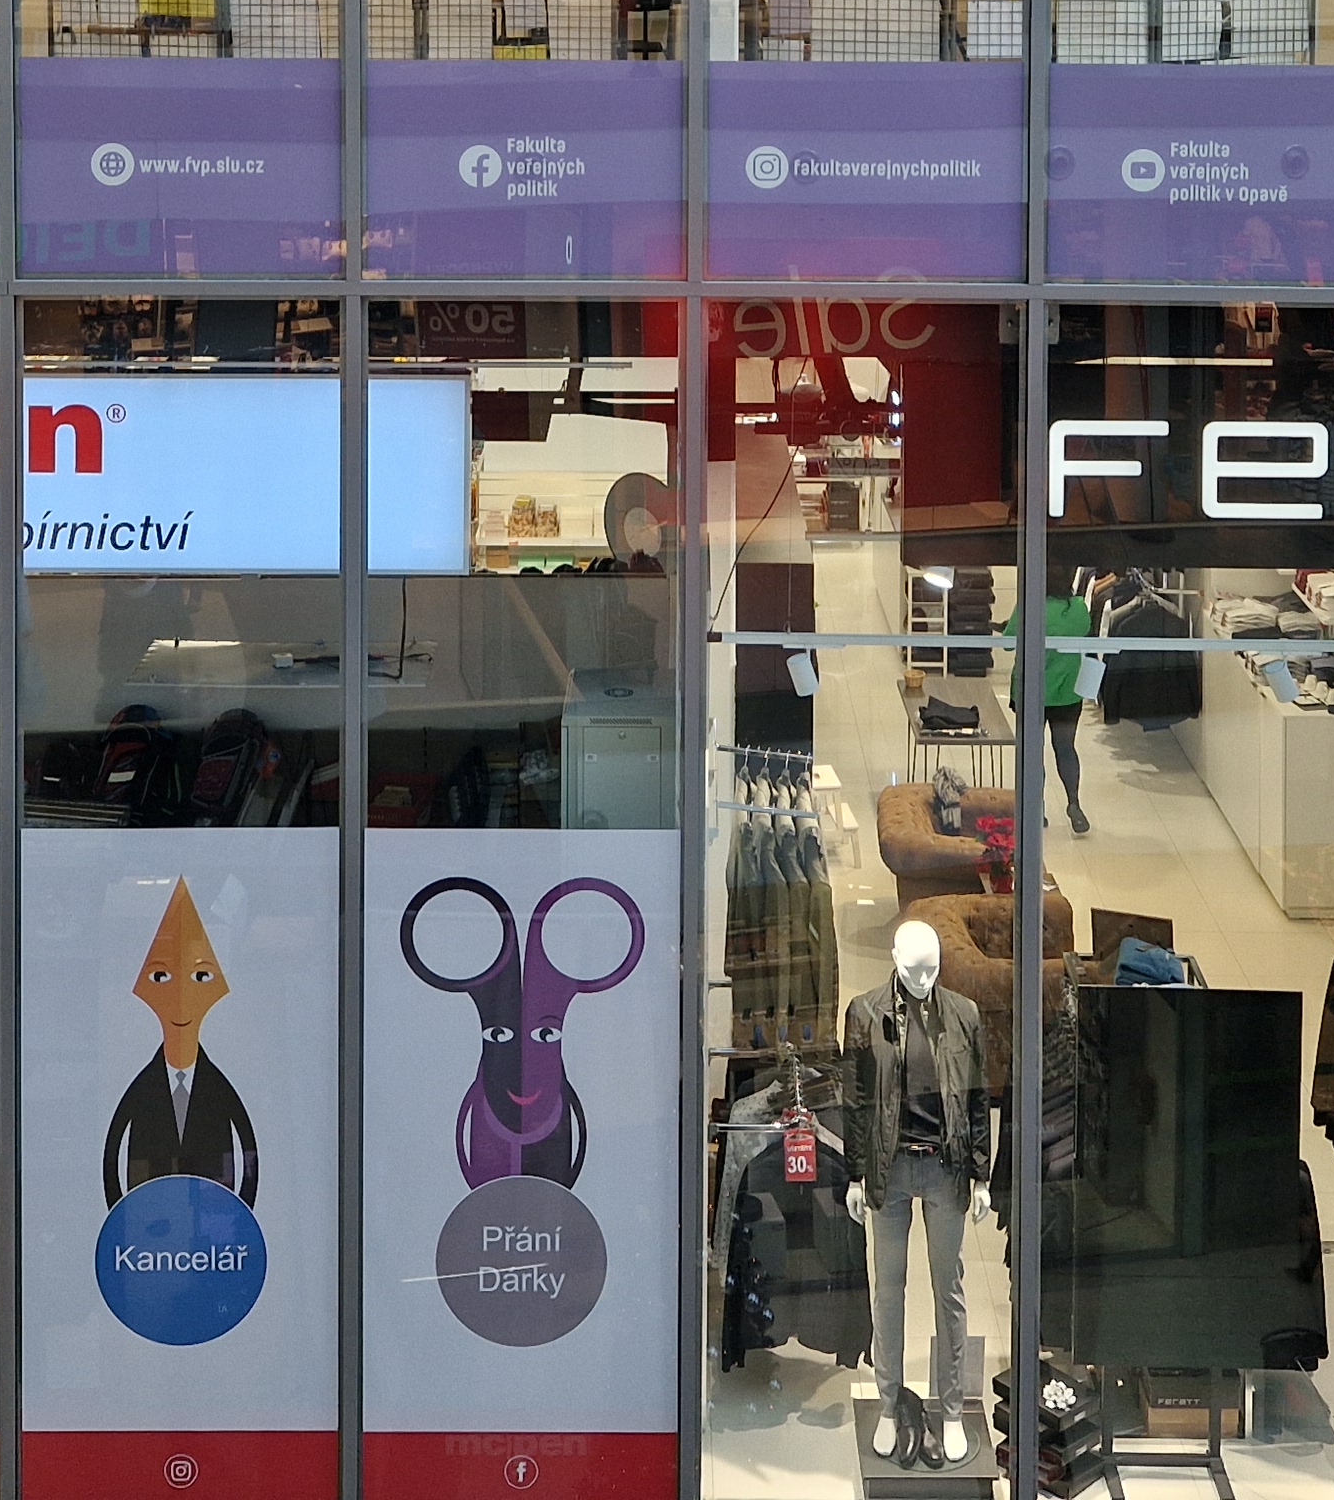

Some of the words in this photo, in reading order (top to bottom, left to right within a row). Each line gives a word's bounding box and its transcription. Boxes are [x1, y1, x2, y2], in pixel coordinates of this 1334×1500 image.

[507, 136, 566, 153] Fakulta
[1170, 141, 1231, 158] Fakulta
[139, 155, 265, 176] www.fvp.slu.cz
[507, 157, 585, 178] veřejných
[793, 157, 981, 180] fakultaverejnychpolitik
[1170, 162, 1249, 182] veřejných
[507, 180, 558, 199] politik
[1170, 184, 1220, 204] politik
[1225, 189, 1235, 201] v
[1239, 185, 1288, 205] Opavě
[481, 1224, 562, 1253] Přání
[114, 1244, 248, 1272] Kancelář
[478, 1266, 566, 1299] Dárky
